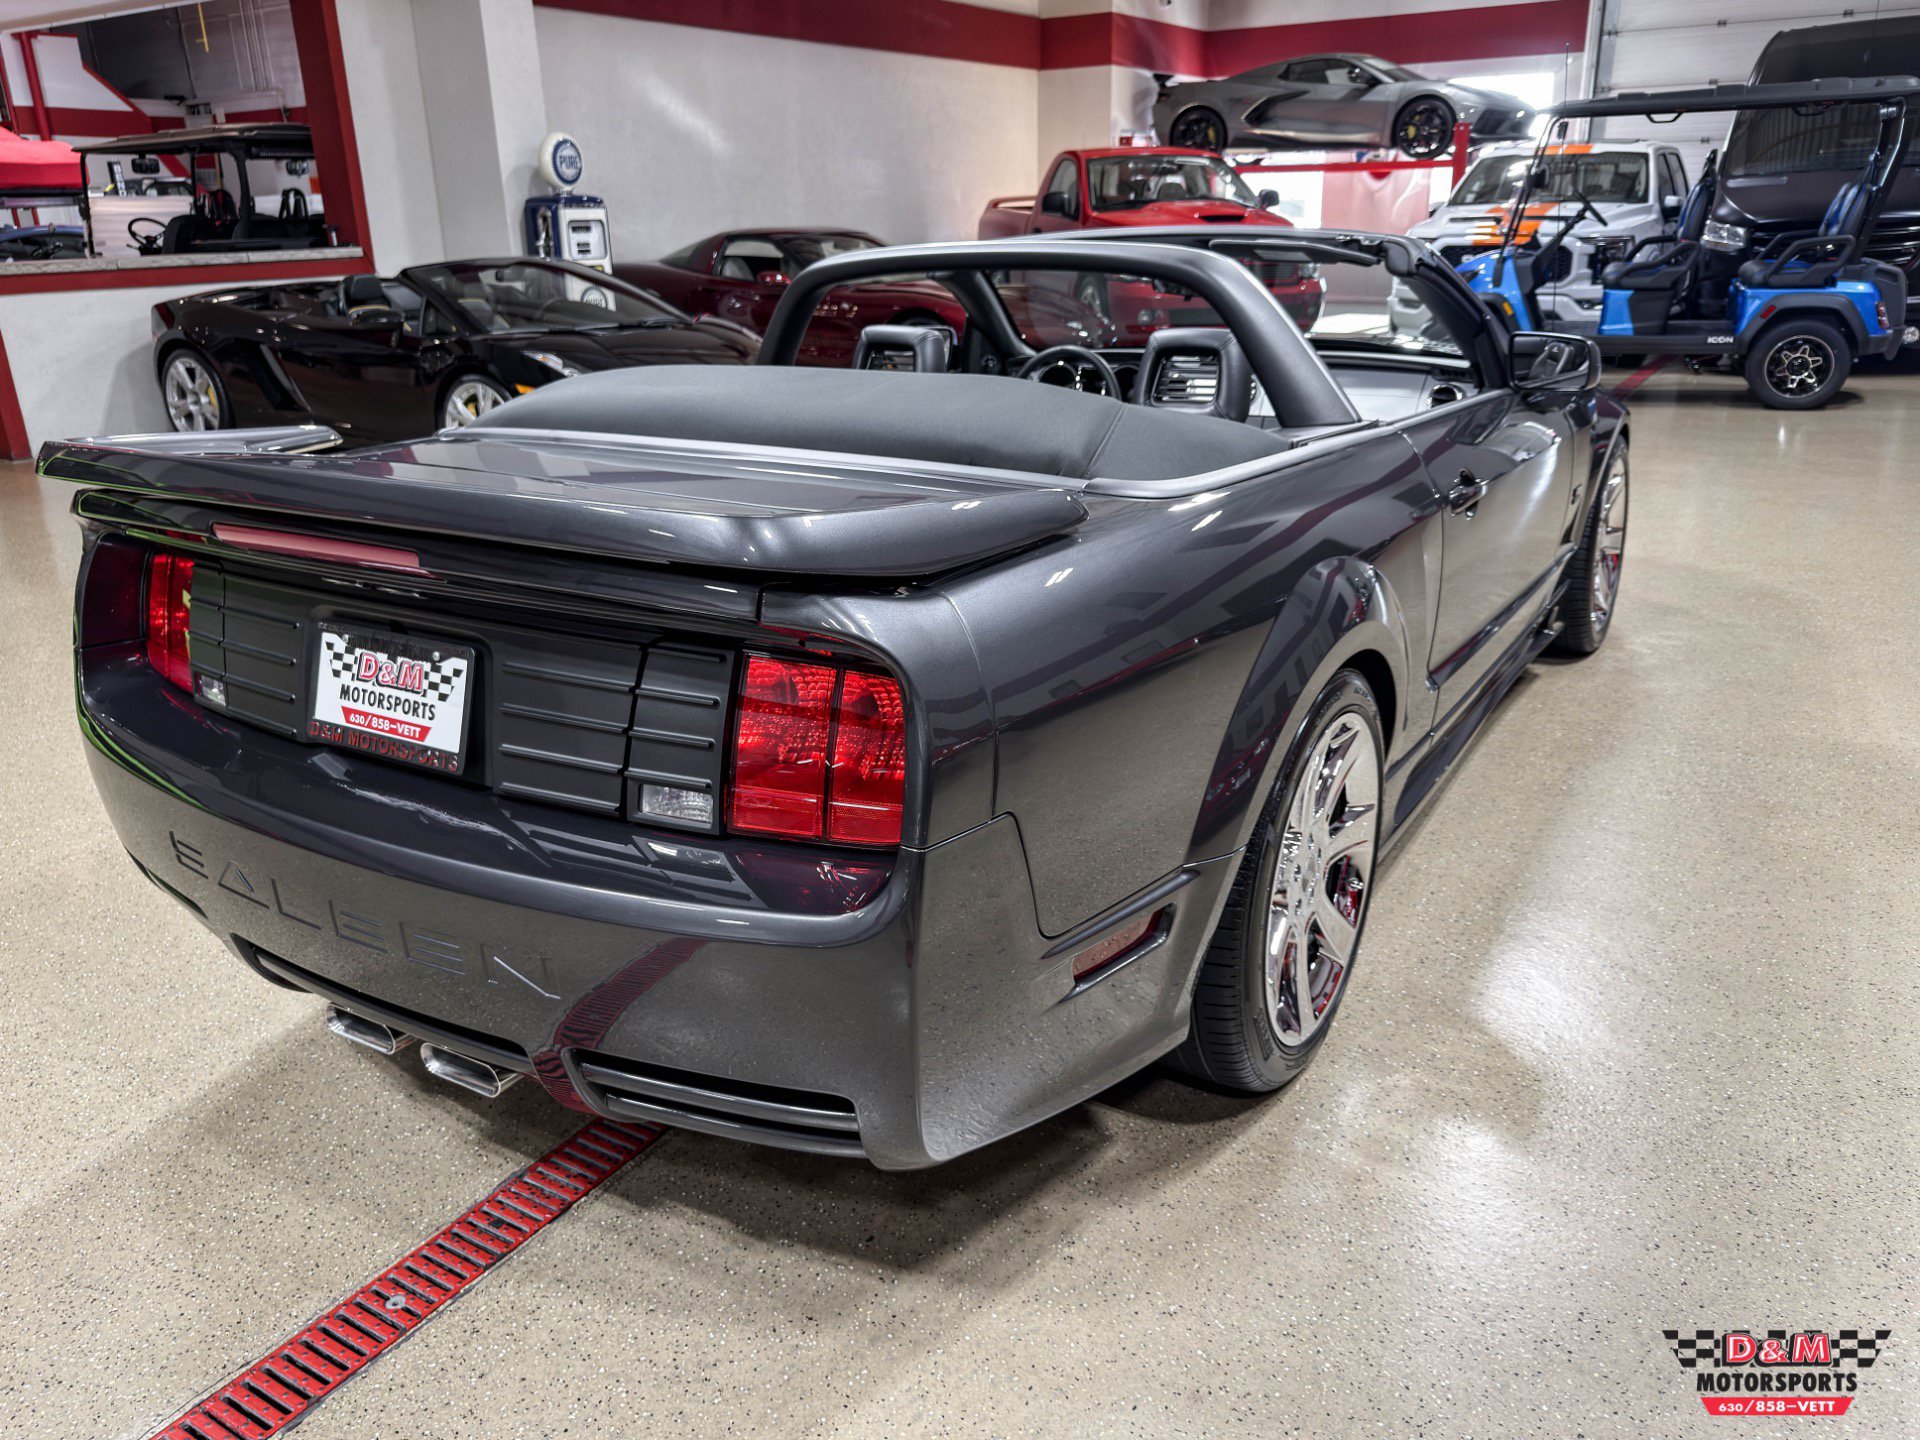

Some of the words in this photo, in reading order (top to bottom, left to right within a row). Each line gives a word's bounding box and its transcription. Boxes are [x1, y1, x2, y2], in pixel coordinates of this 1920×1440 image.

[558, 155, 581, 170] PURE
[1707, 335, 1734, 344] ICON
[357, 652, 425, 694] D&M
[340, 684, 436, 721] MOTORSPORTS
[310, 721, 344, 743] D&M
[348, 731, 459, 772] MOTORSPORTS
